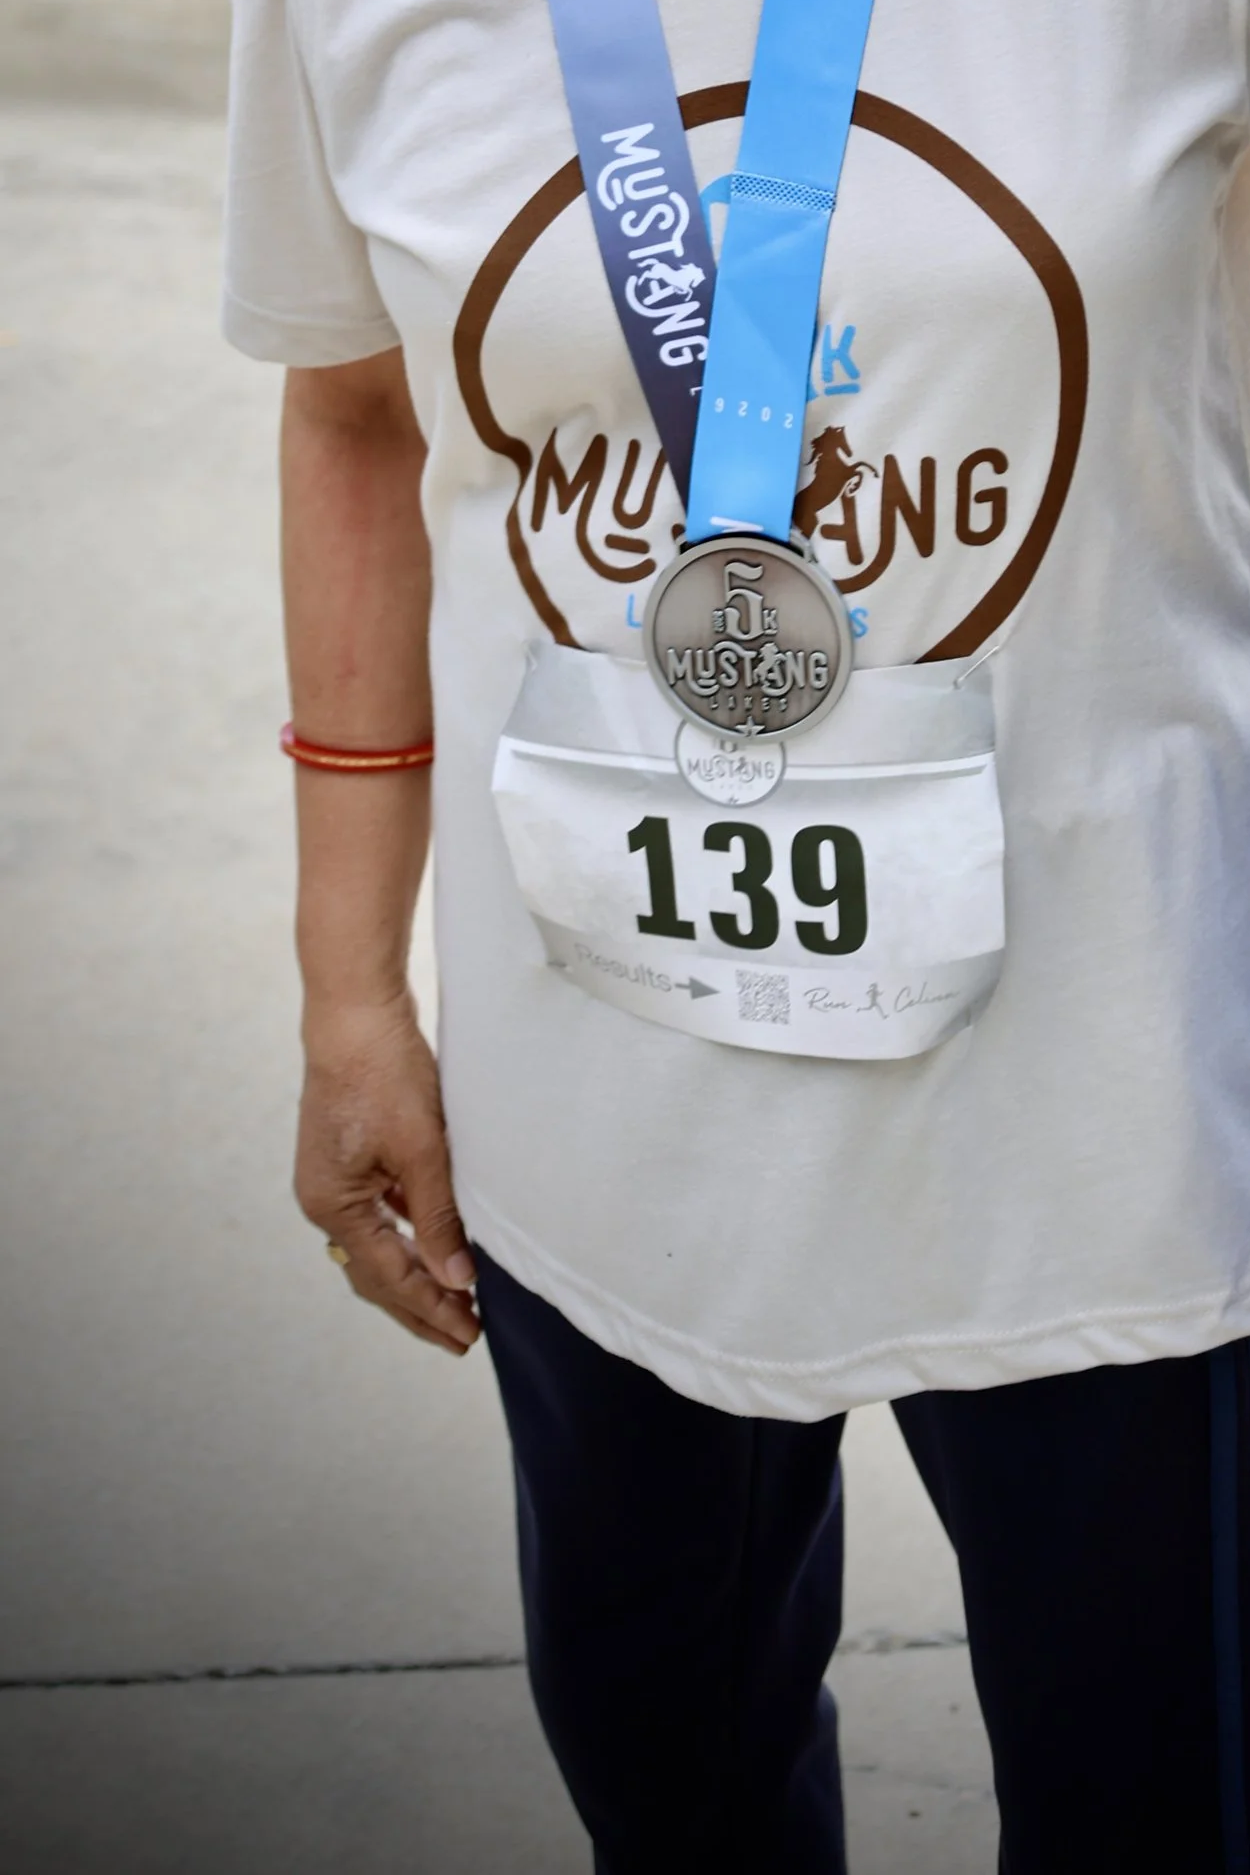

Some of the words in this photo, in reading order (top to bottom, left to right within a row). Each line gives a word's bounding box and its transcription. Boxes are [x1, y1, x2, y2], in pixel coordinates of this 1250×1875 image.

[597, 123, 709, 367] MUSTANG
[714, 397, 794, 429] 2026
[530, 425, 1010, 592] MUANG
[667, 640, 829, 696] MUSTANG
[627, 815, 868, 955] 139
[574, 942, 674, 993] Results
